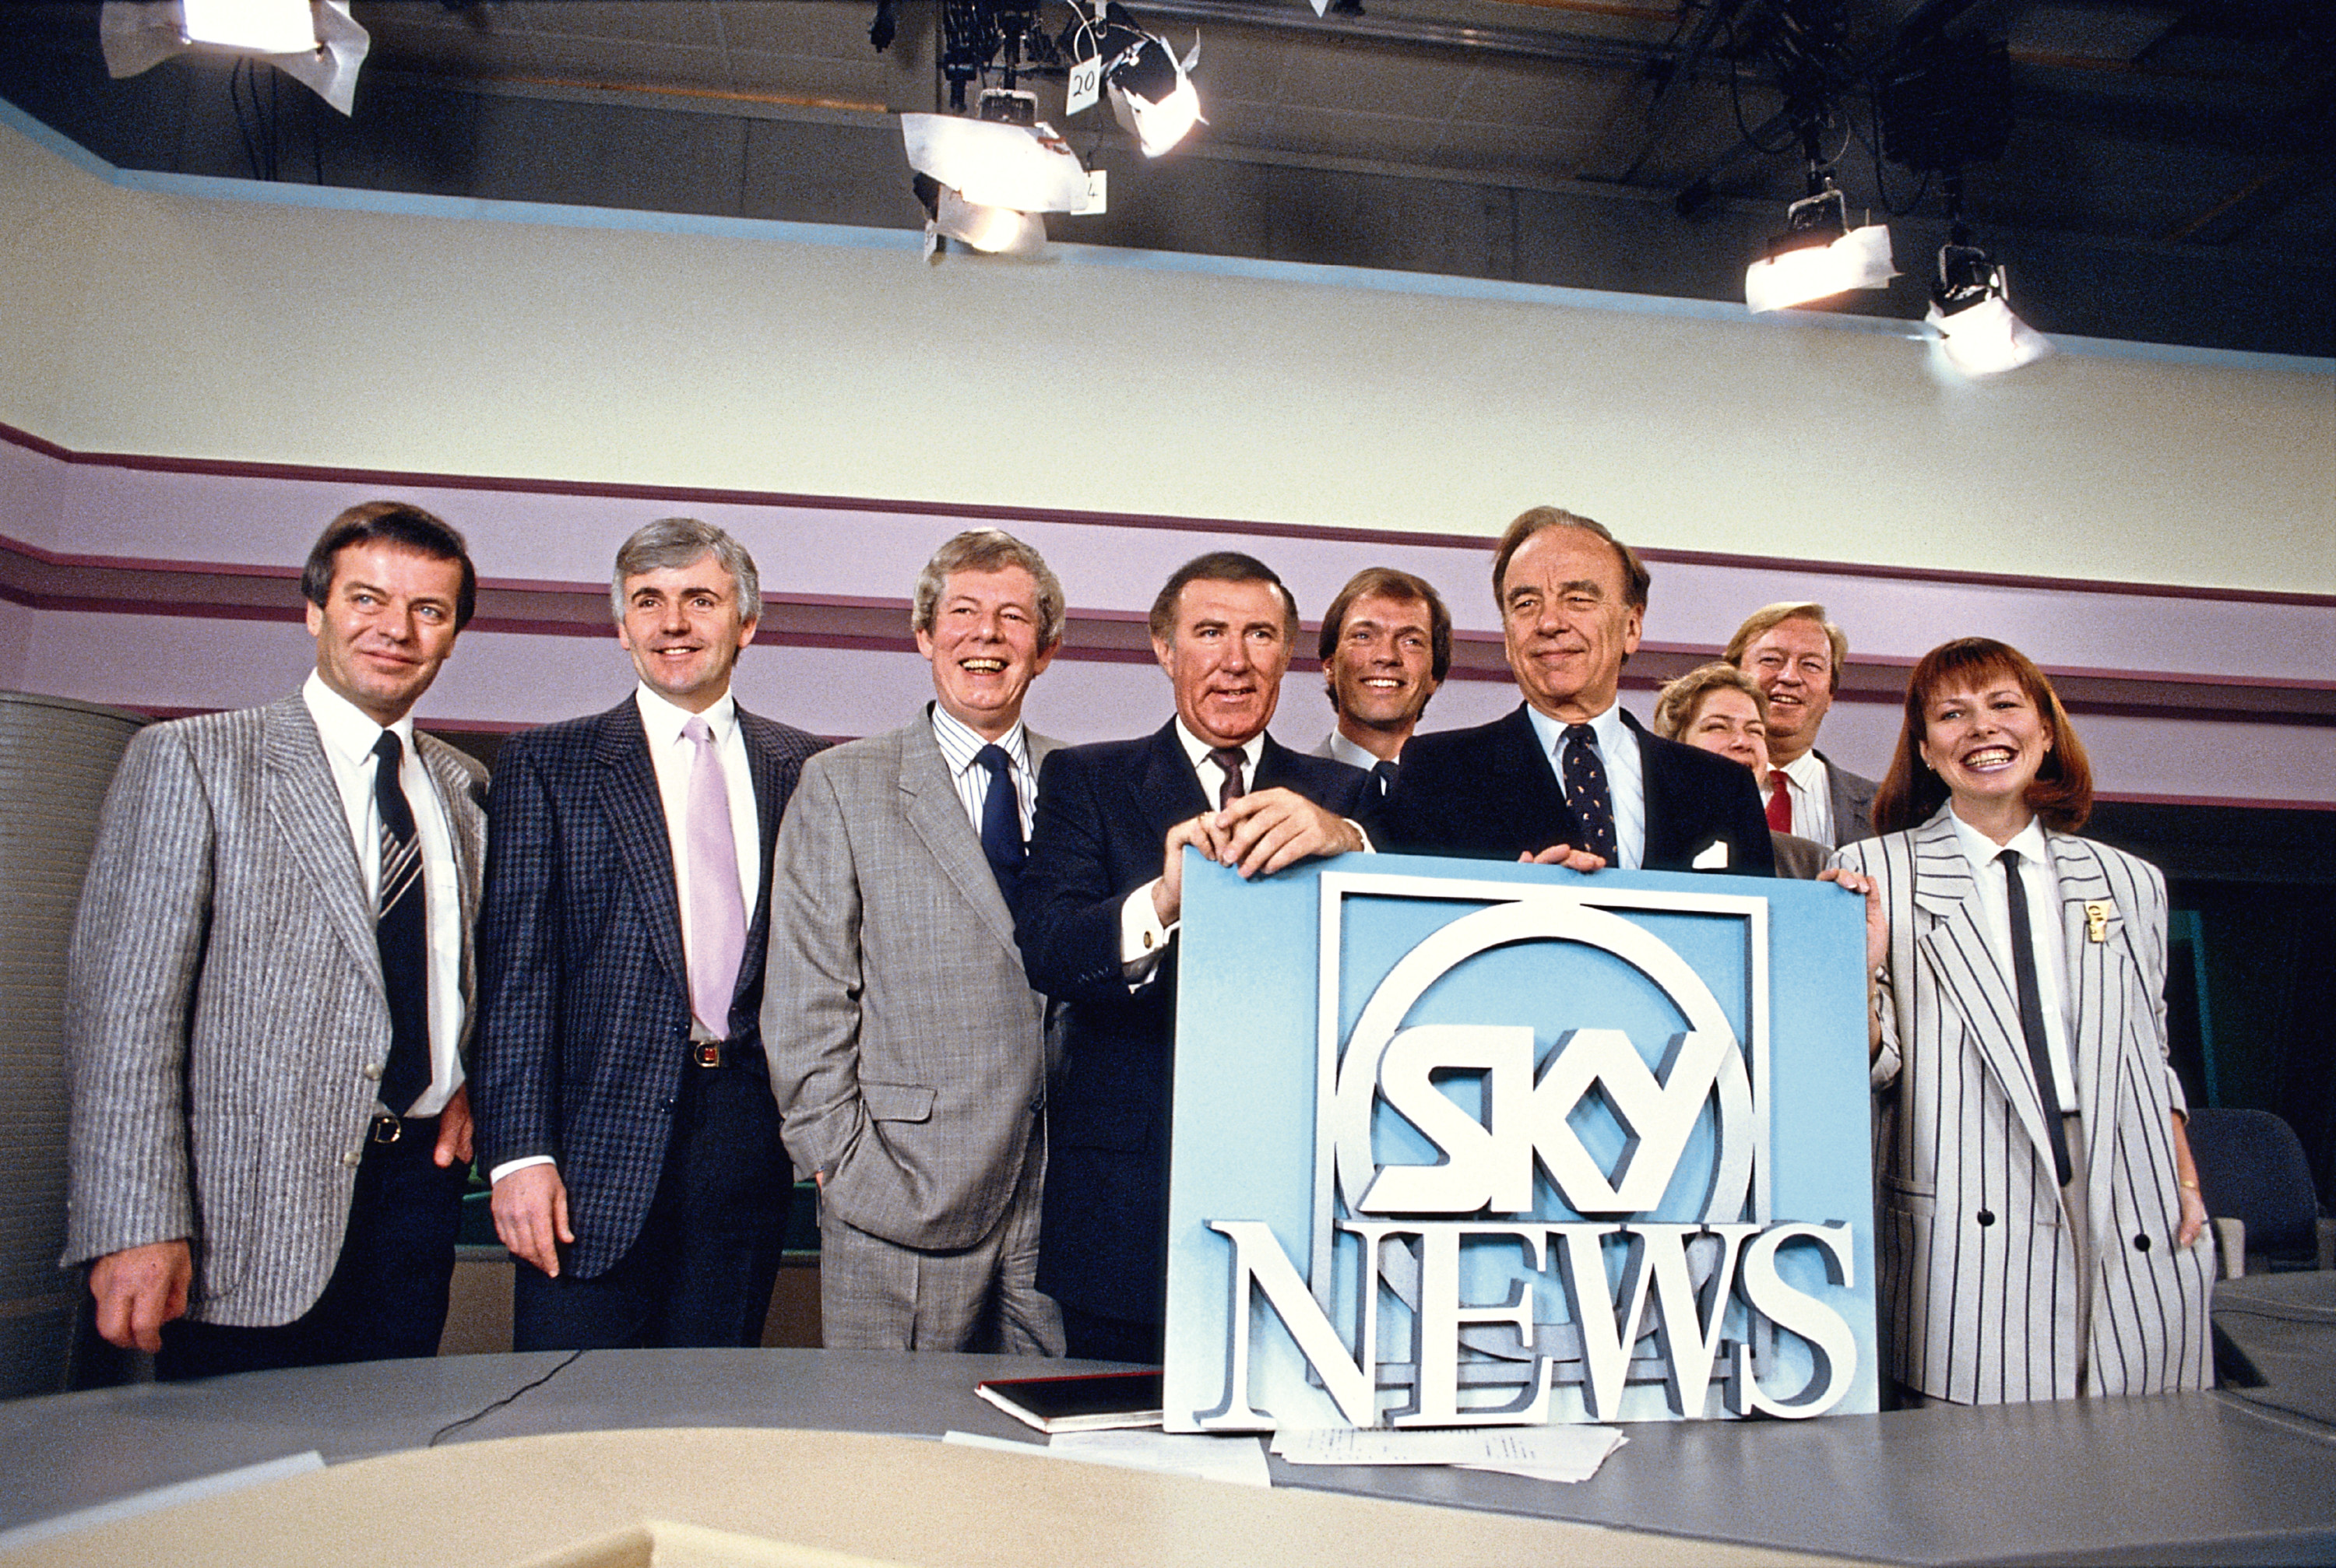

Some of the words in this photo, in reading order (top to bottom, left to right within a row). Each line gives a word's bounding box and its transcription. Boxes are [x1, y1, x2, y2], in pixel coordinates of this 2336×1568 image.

[1074, 71, 1095, 97] 20
[1357, 1025, 1736, 1212] SKY
[1194, 1218, 1857, 1428] NEWS
